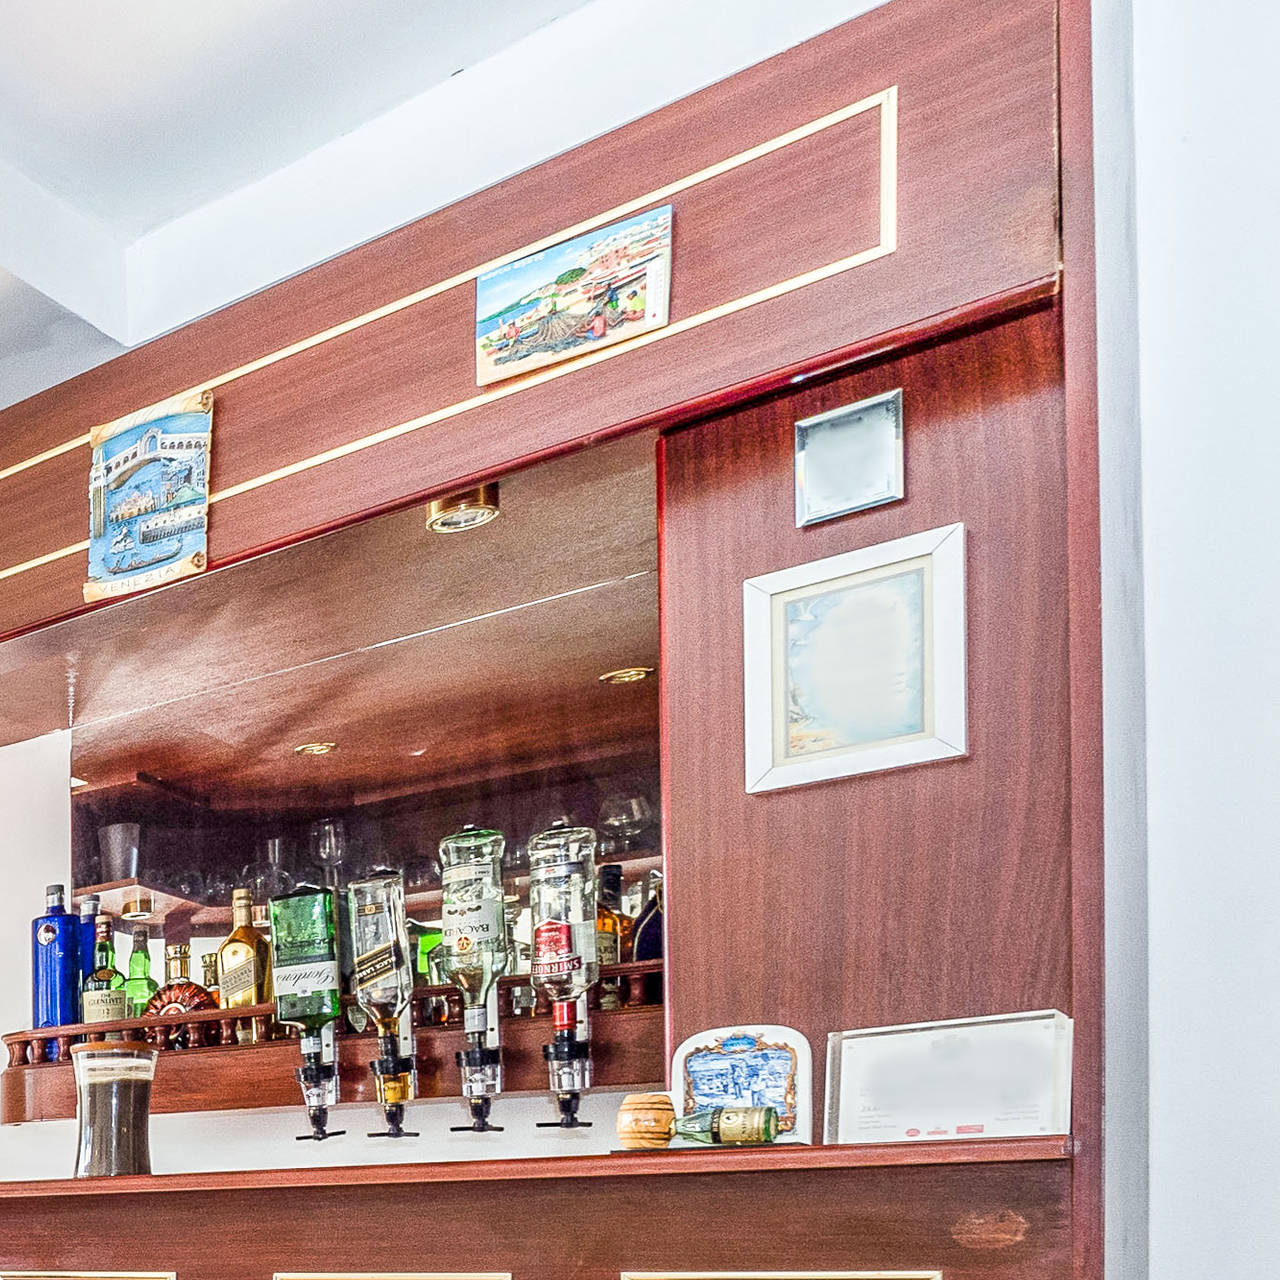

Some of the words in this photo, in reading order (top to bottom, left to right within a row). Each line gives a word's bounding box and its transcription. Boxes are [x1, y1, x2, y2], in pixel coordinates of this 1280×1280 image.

[98, 566, 176, 593] VENEZIA
[444, 922, 490, 938] BACARD
[532, 959, 580, 974] SMIRNOFF
[88, 997, 122, 1006] GLENLIVET
